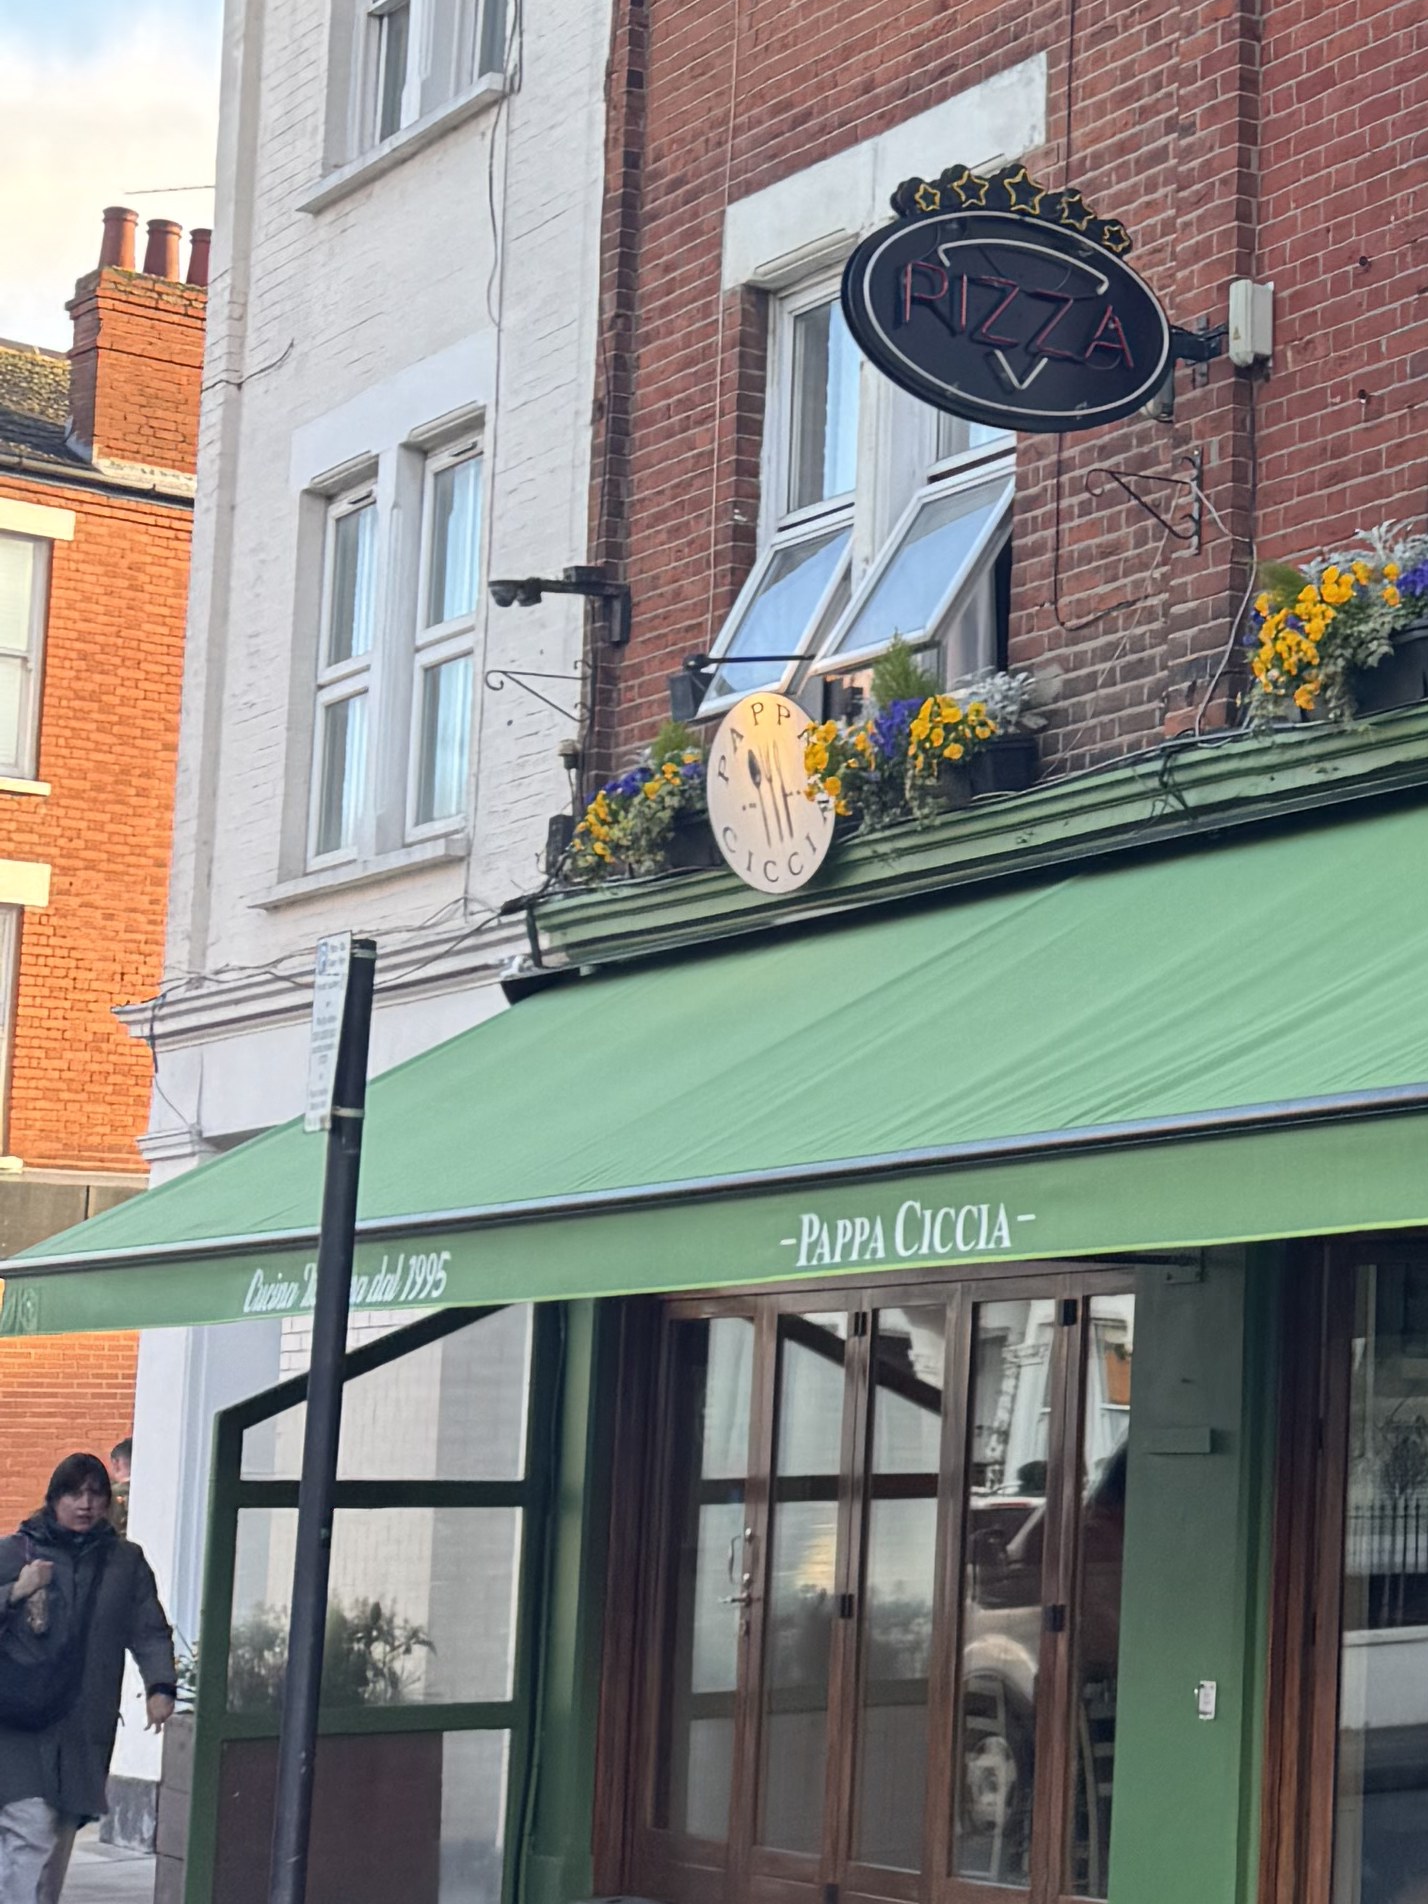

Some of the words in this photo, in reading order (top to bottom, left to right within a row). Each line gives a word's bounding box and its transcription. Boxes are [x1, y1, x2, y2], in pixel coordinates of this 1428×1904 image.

[904, 260, 1134, 369] PIZZA
[243, 1268, 300, 1313] Cucina
[365, 1252, 405, 1303] dal
[398, 1249, 452, 1302] 1995
